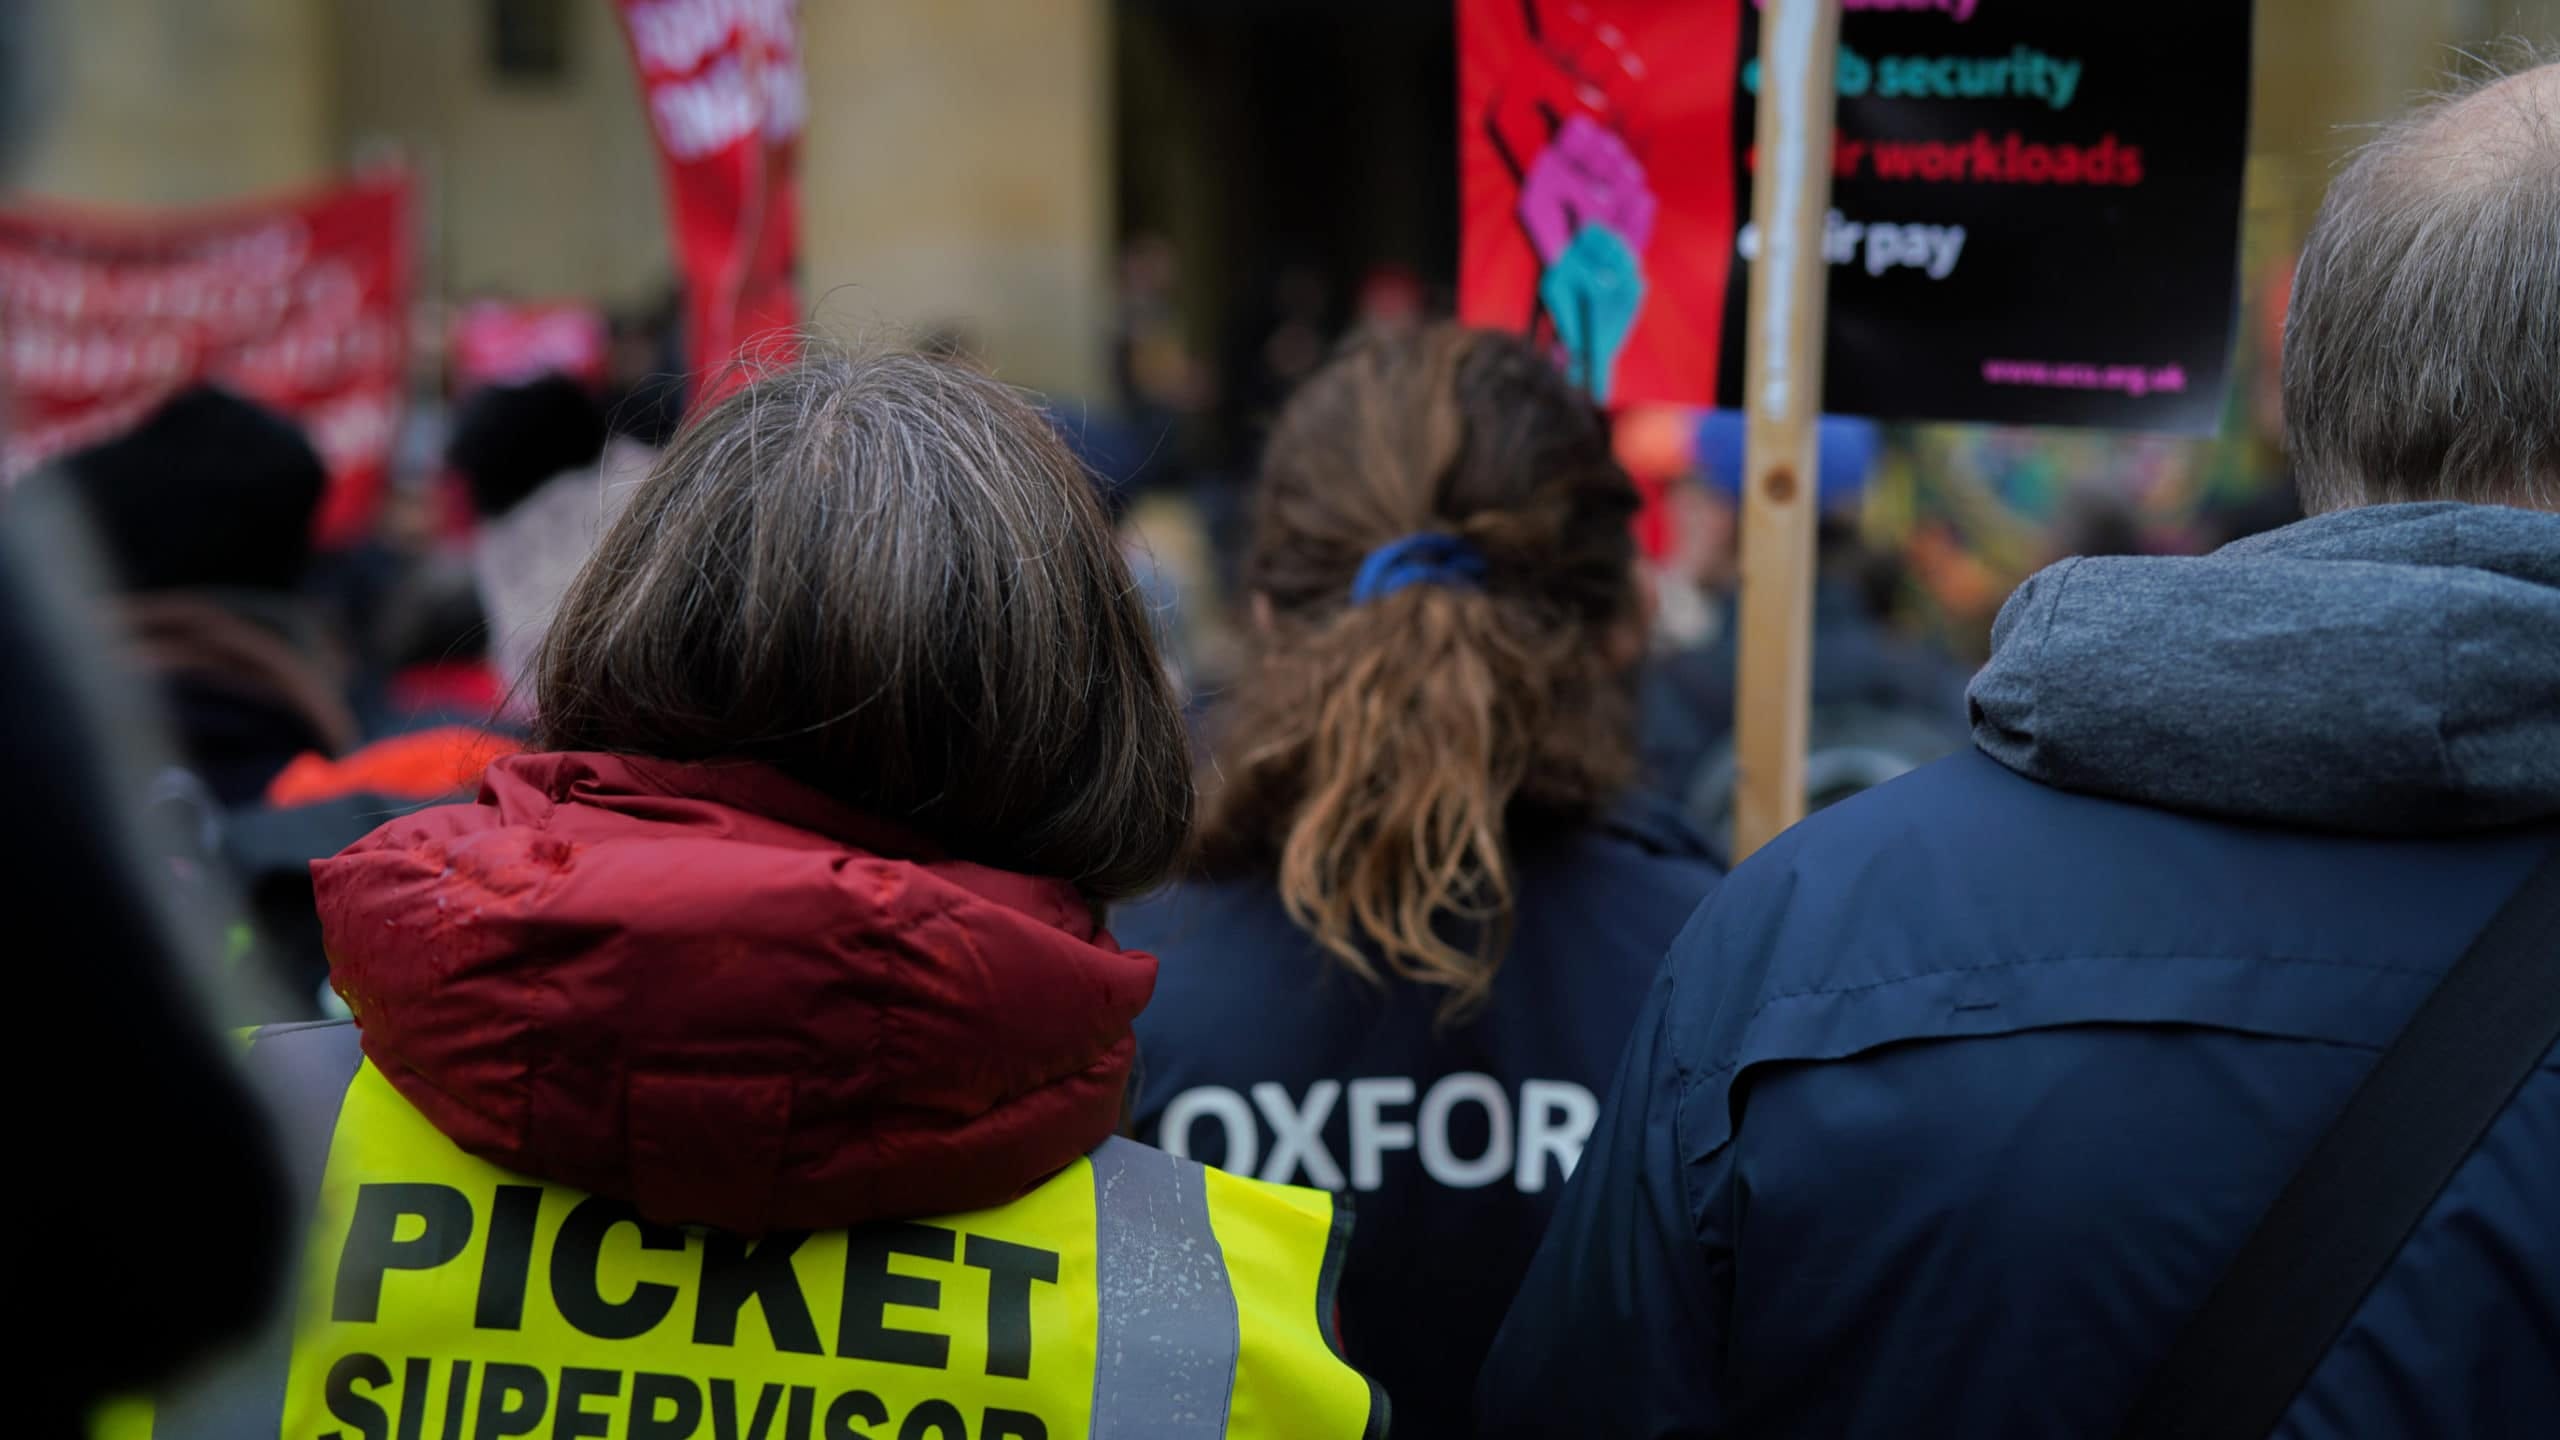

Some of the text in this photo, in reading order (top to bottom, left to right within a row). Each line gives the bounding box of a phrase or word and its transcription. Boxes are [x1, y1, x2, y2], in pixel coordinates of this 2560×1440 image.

[1877, 47, 2081, 108] security
[1874, 133, 2144, 187] workloads
[1865, 222, 1966, 279] pay
[1159, 1072, 1600, 1192] OXFOR
[331, 1183, 1059, 1379] PICKET
[318, 1353, 1048, 1440] SUPERVI
